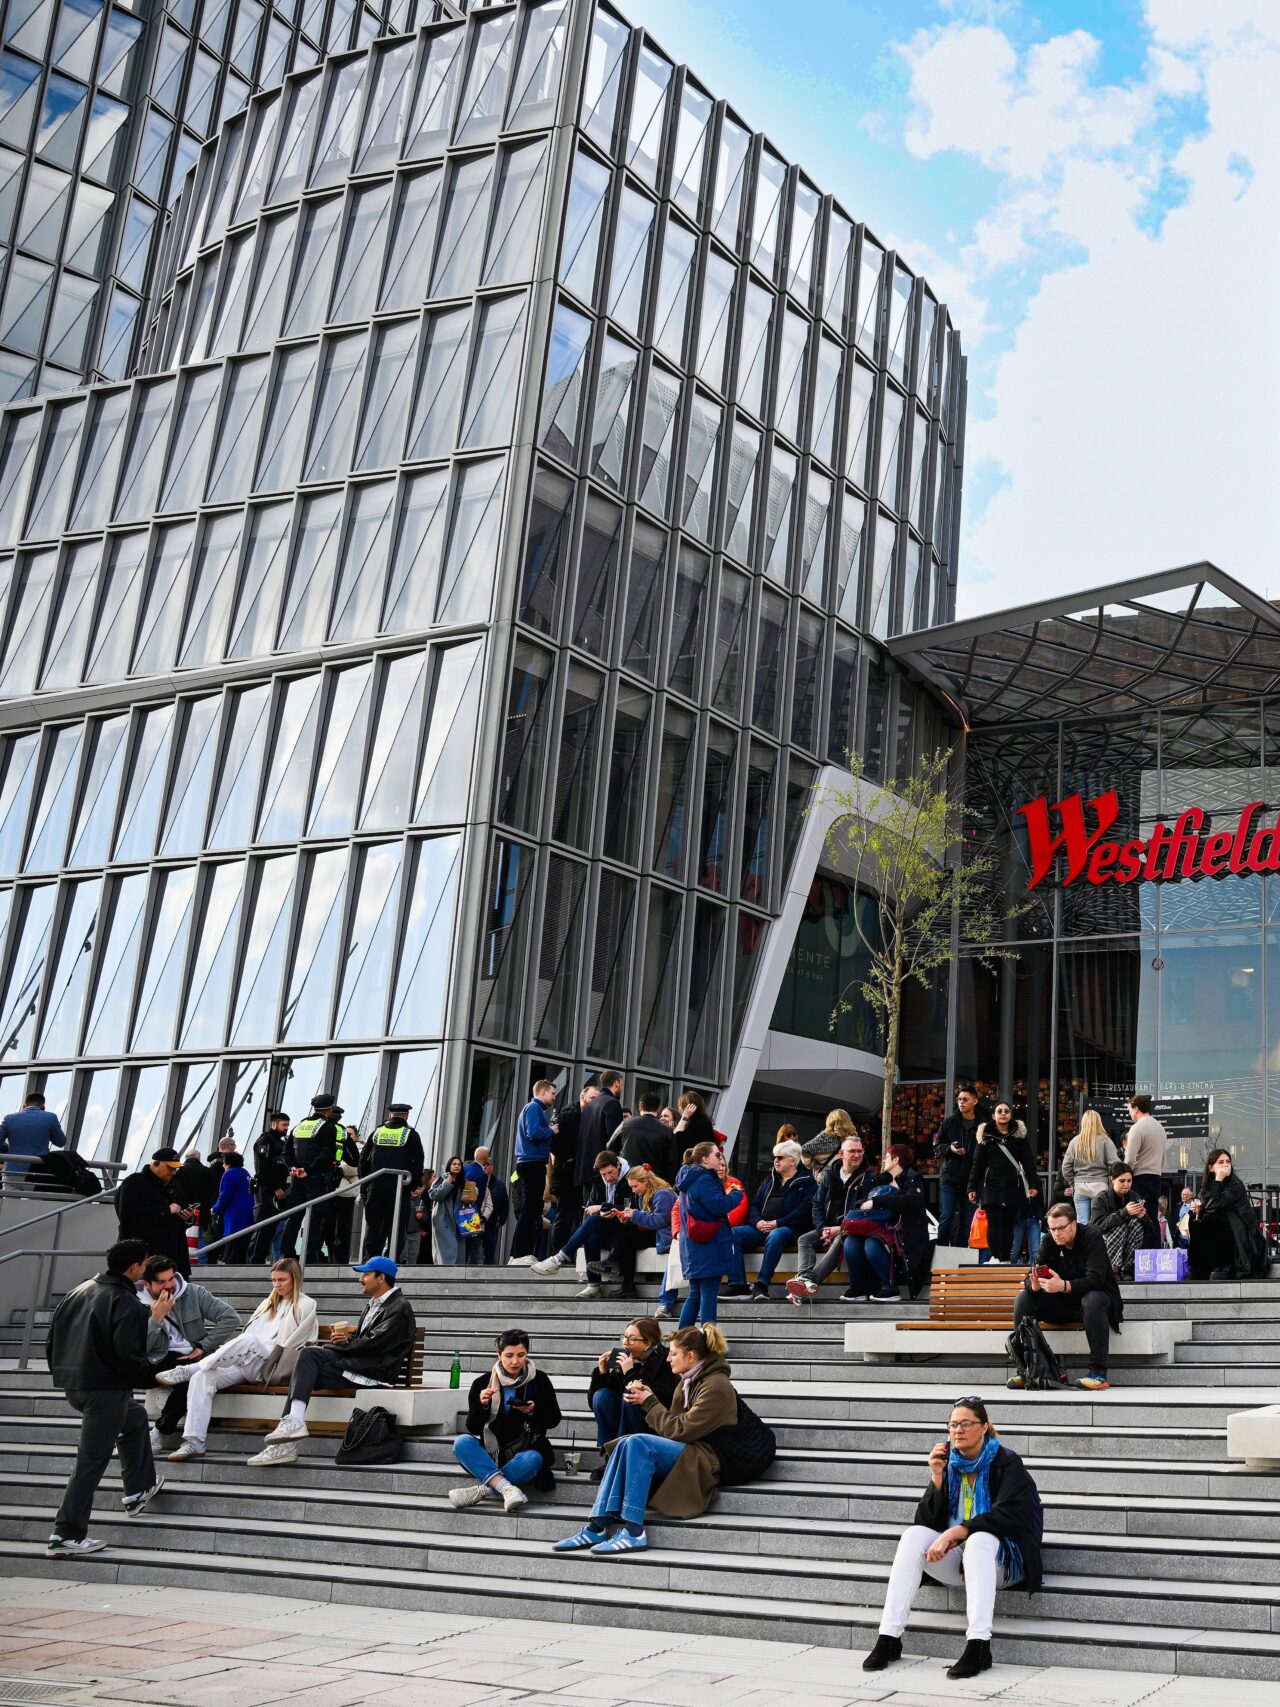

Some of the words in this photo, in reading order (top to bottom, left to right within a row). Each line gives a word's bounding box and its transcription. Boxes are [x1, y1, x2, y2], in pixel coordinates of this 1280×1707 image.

[1109, 1083, 1154, 1092] RESTAURANT
[1160, 1082, 1177, 1091] BARS
[1188, 1081, 1214, 1090] CINEMA
